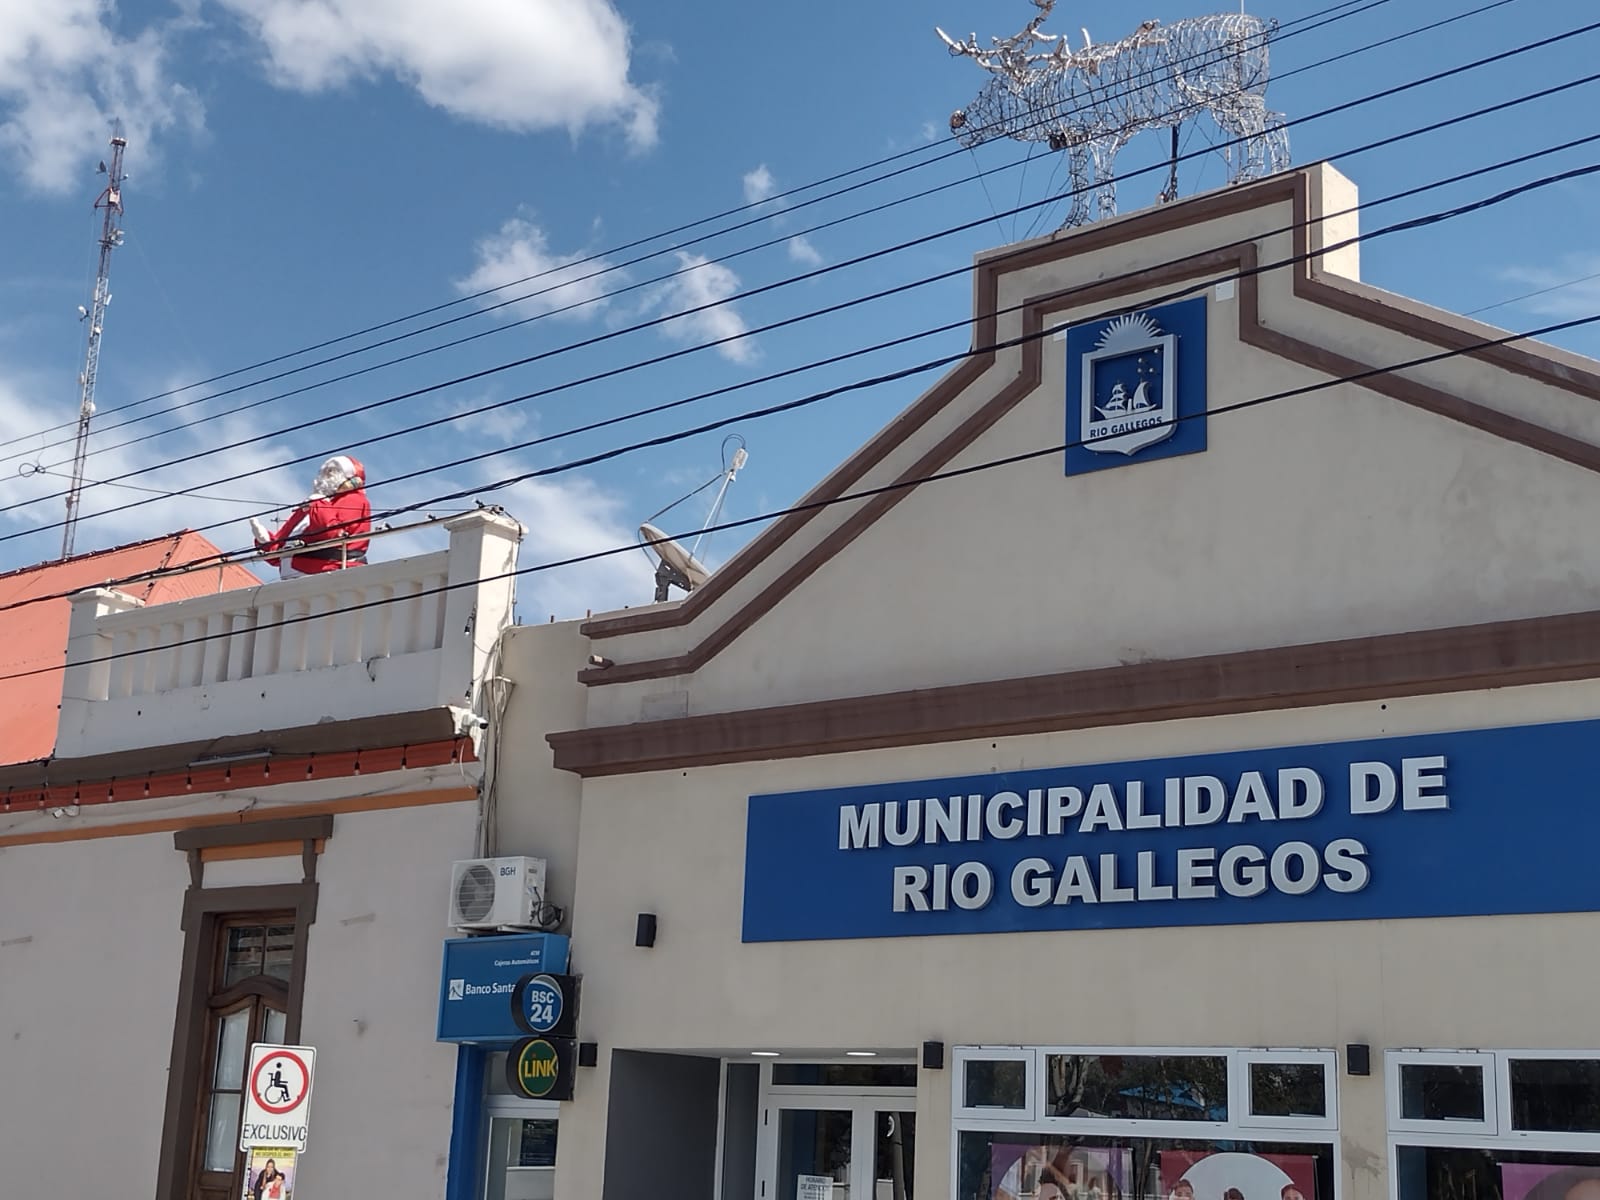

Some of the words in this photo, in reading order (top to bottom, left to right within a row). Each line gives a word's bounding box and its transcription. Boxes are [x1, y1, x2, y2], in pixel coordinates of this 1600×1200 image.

[1090, 427, 1108, 438] RIO
[1111, 416, 1162, 432] GALLEGOS
[838, 766, 1325, 851] MUNICIPALIDAD
[1349, 755, 1450, 815] DE
[500, 867, 516, 876] BGH
[892, 861, 994, 913] RIO
[1011, 837, 1370, 908] GALLEGOS
[465, 983, 491, 995] Banco
[531, 990, 554, 1004] BSC
[530, 1004, 554, 1023] 24
[524, 1054, 558, 1078] LINK
[243, 1124, 307, 1142] EXCLUSIVO
